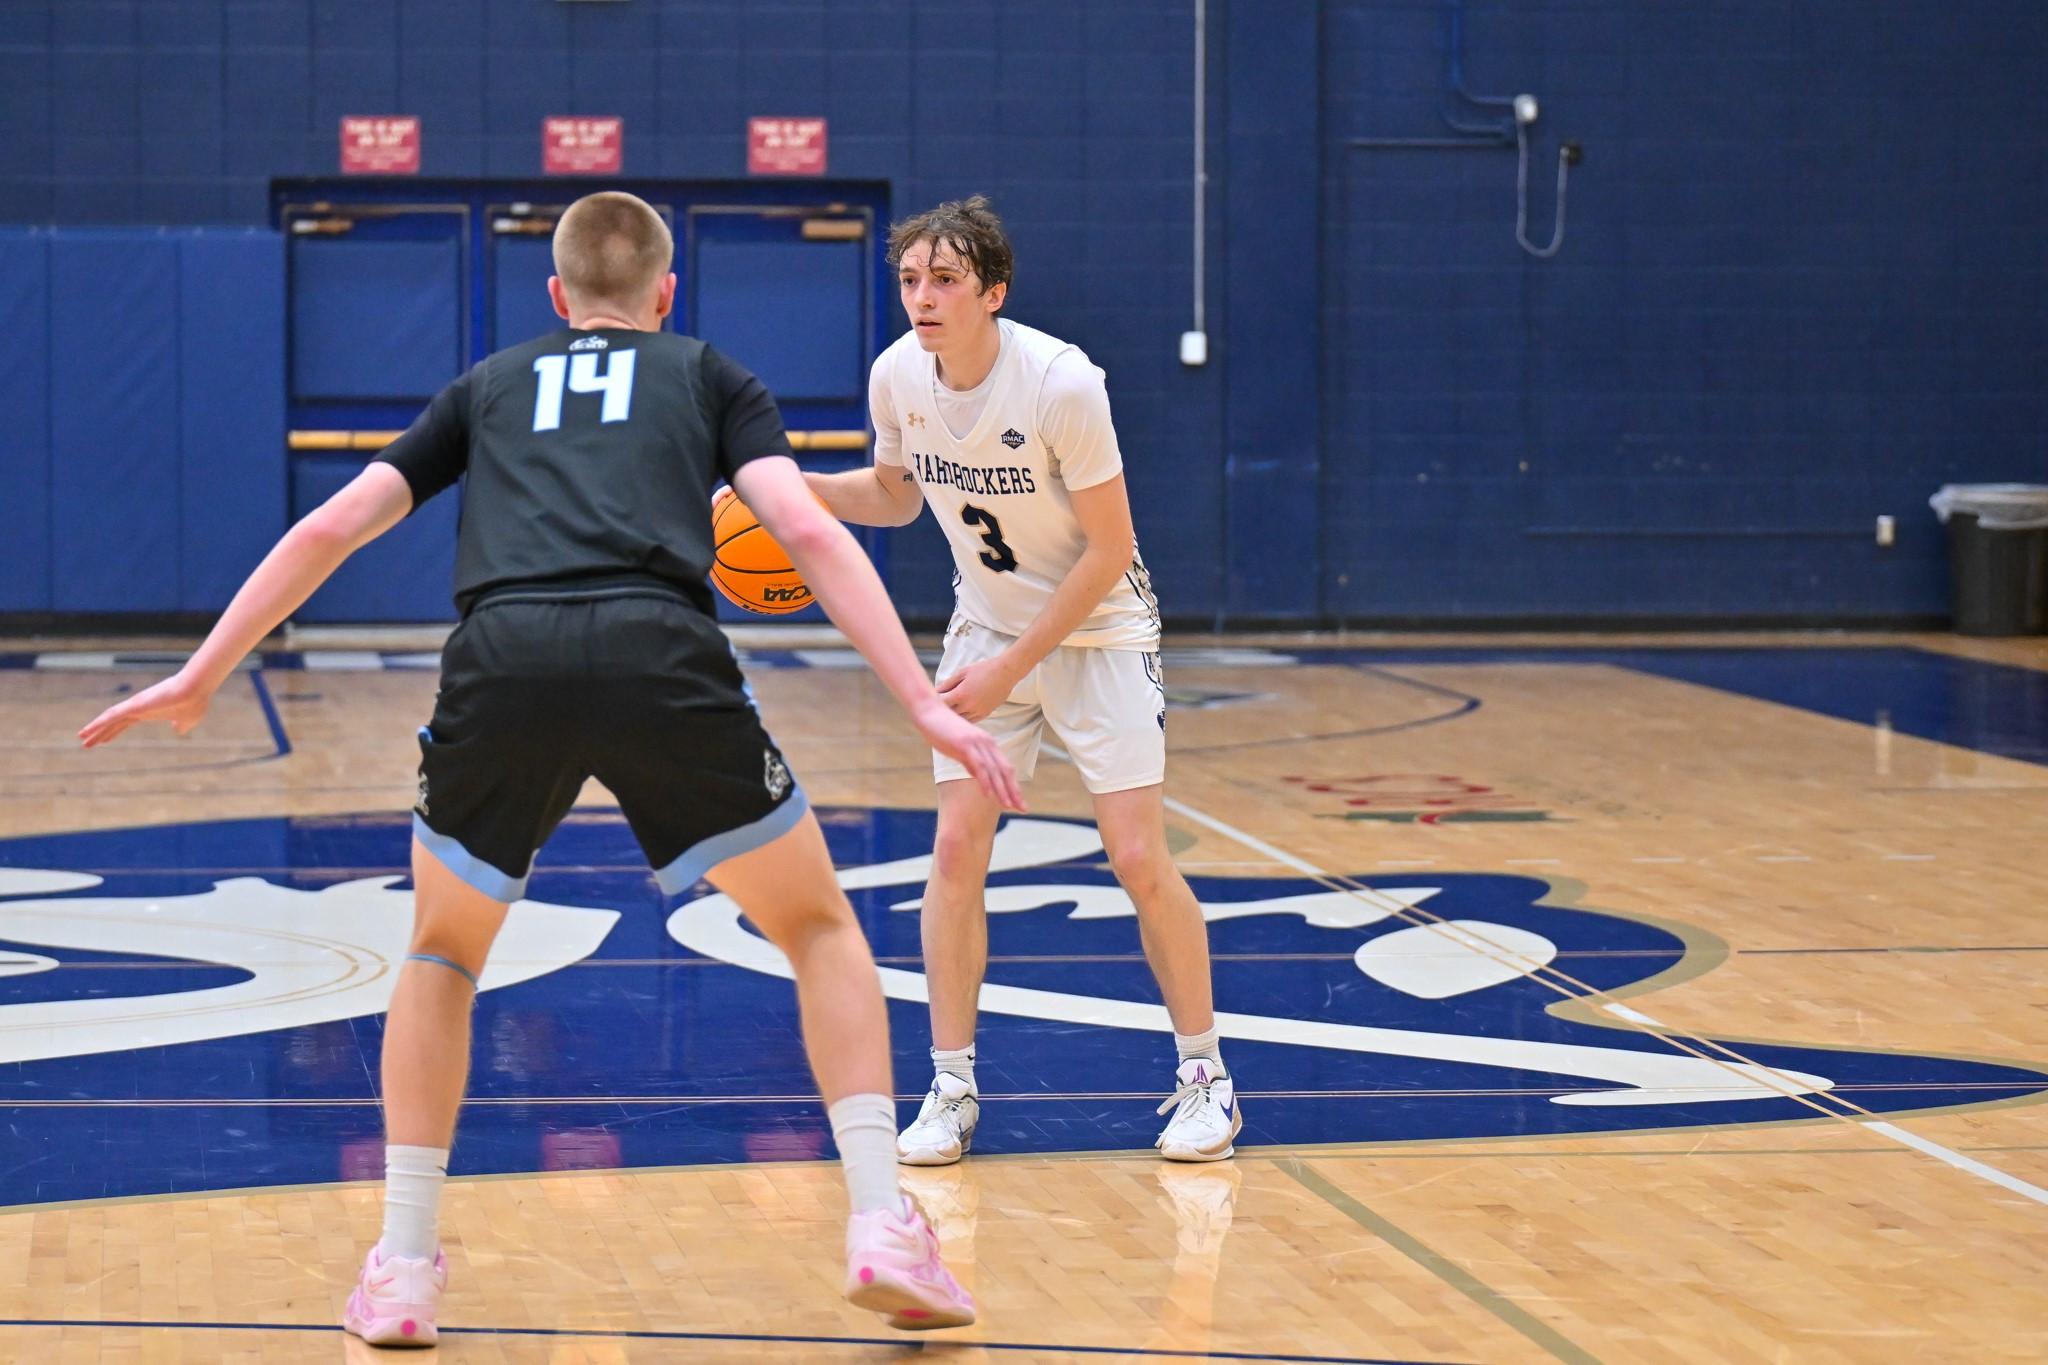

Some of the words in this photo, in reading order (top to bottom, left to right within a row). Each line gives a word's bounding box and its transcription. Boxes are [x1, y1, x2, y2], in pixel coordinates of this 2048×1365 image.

[533, 347, 637, 432] 14
[1003, 435, 1024, 443] RMAC
[960, 502, 1019, 574] 3
[764, 585, 812, 602] CAA
